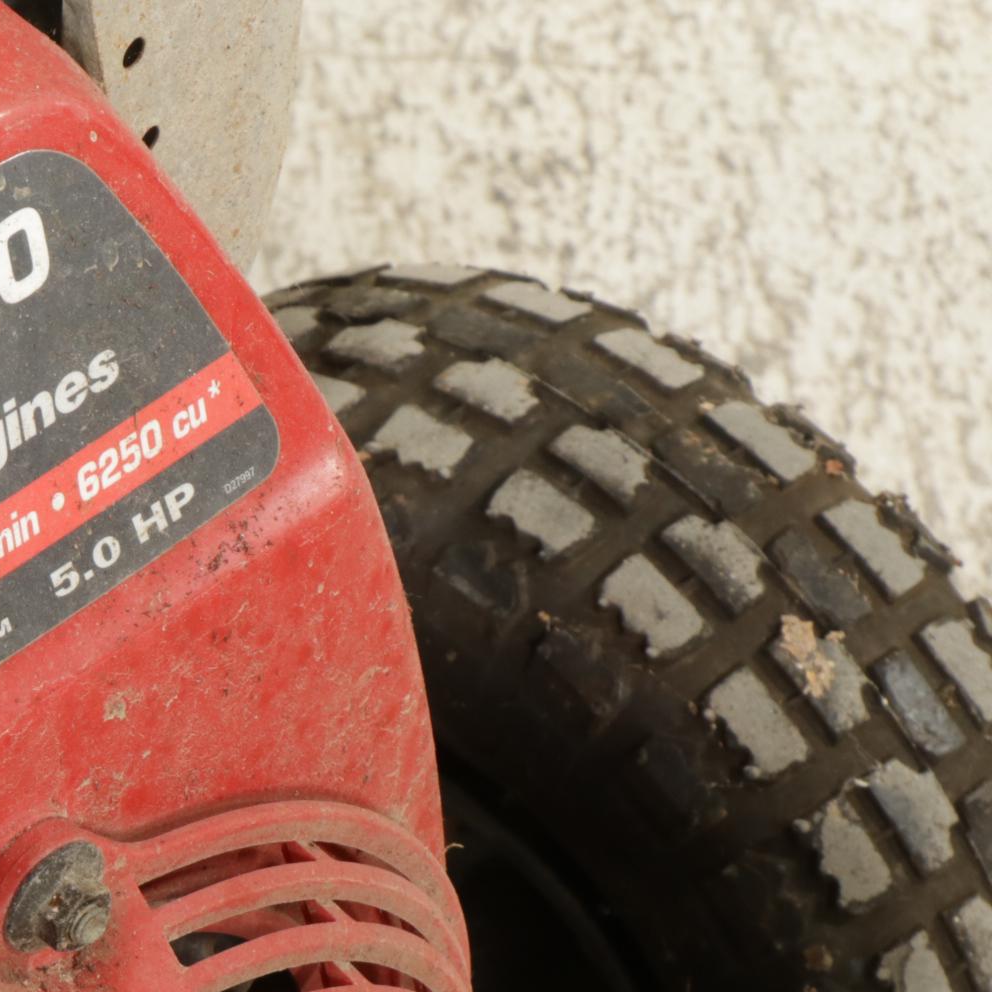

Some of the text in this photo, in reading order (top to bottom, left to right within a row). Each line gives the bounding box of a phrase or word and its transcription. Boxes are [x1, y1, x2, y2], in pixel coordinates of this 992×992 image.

[76, 419, 163, 502] 6250
[49, 536, 121, 598] 5.0
[130, 482, 195, 545] HP
